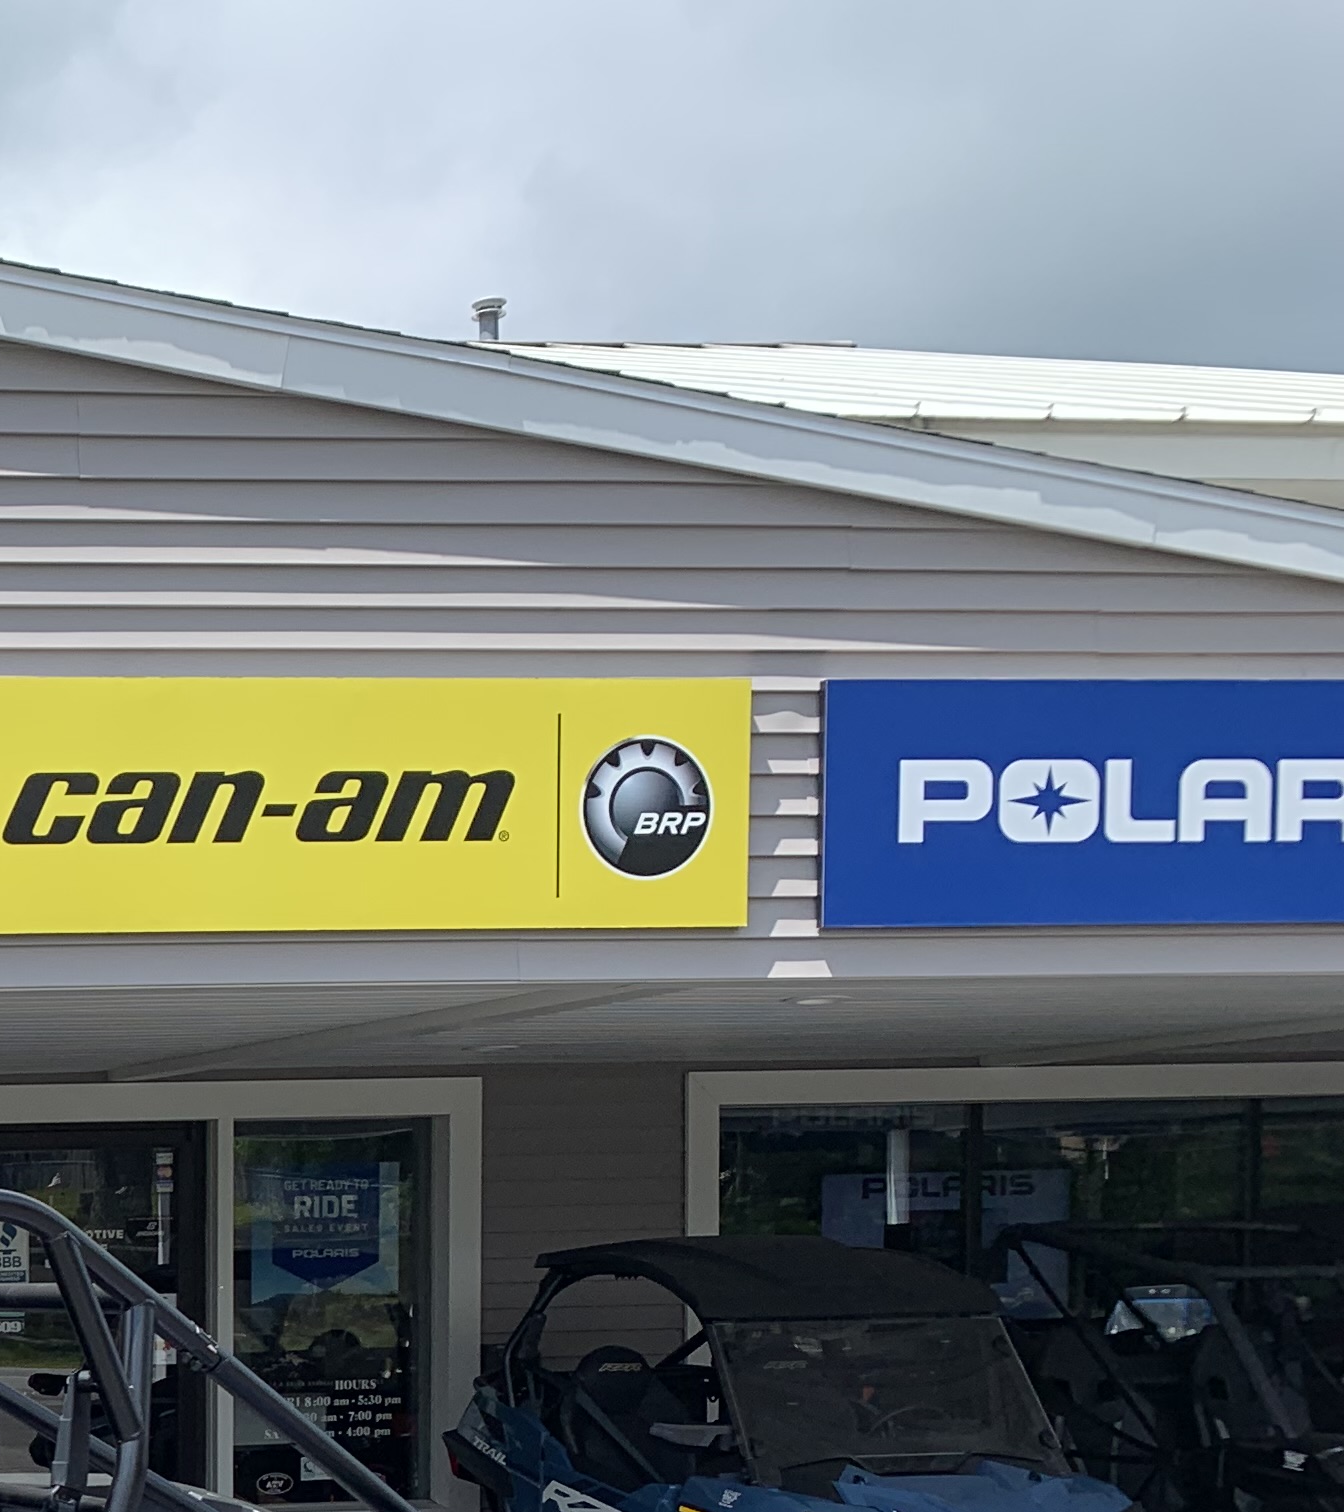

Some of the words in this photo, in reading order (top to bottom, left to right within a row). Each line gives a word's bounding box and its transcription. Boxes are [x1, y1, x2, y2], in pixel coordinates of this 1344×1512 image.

[1, 770, 516, 844] can-am
[898, 758, 1344, 844] POLAR
[634, 811, 707, 836] BRP
[284, 1180, 306, 1191] GET
[310, 1179, 350, 1190] READY
[294, 1194, 359, 1219] RIDE
[284, 1224, 323, 1233] SALES
[329, 1223, 368, 1233] EVENT
[292, 1248, 360, 1259] POLARIS
[334, 1379, 377, 1390] HOURS
[304, 1396, 331, 1407] 8:00
[333, 1398, 349, 1406] am
[357, 1395, 382, 1406] 5:30
[384, 1396, 401, 1407] pm
[348, 1411, 372, 1422] 7:00
[375, 1412, 392, 1423] pm
[346, 1426, 370, 1437] 4:00
[374, 1428, 391, 1439] pm
[472, 1436, 508, 1466] TRAIL
